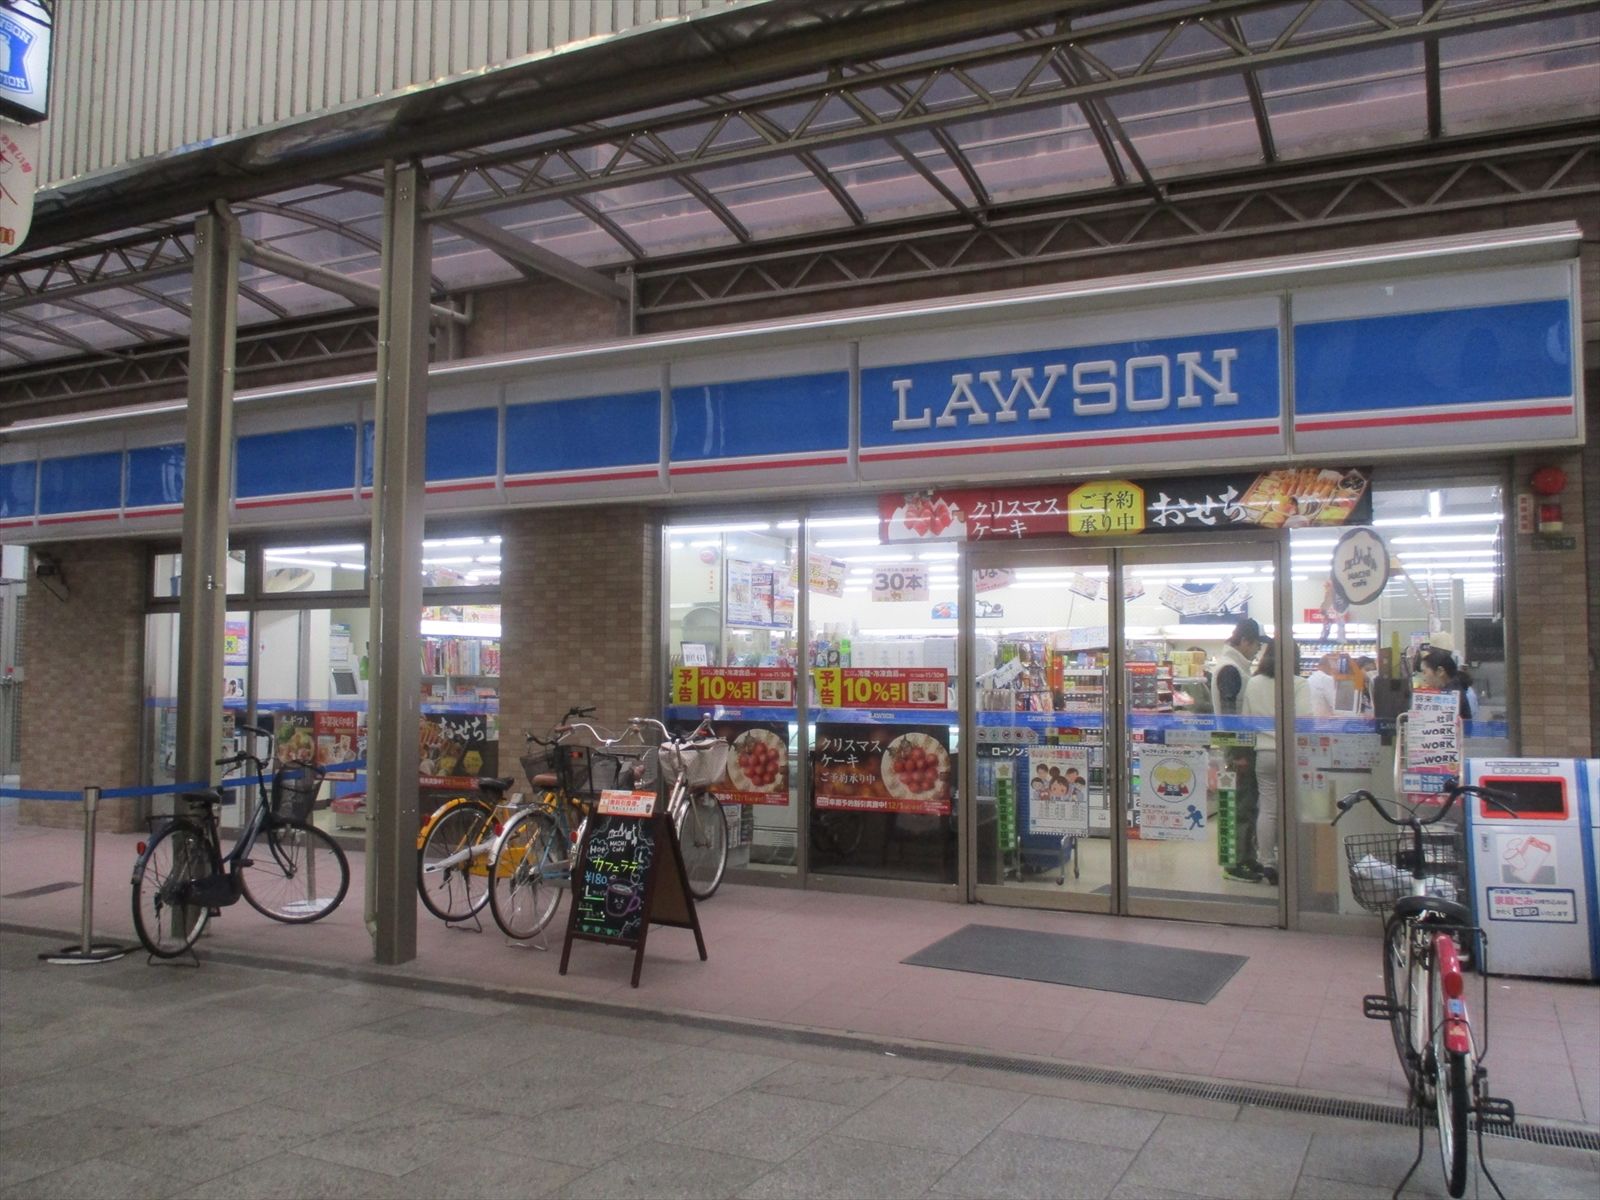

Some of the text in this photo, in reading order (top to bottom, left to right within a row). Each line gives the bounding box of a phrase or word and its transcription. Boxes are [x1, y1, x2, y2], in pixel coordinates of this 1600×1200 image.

[891, 347, 1240, 432] LAWSON
[966, 497, 1061, 521] クリスマス
[1079, 490, 1134, 511] ご予約
[1151, 484, 1248, 527] おせち
[970, 519, 1028, 541] ケーキ
[1079, 511, 1135, 533] 承り中
[874, 572, 923, 592] 30本
[700, 676, 757, 700] 10%引
[819, 670, 835, 705] 予告
[843, 677, 907, 703] 10%引
[438, 715, 486, 742] おせち
[1422, 727, 1455, 736] WORK
[820, 737, 882, 752] クリスマス
[1421, 740, 1455, 750] WORK
[819, 755, 860, 769] ケーキ
[1423, 753, 1458, 764] WORK
[592, 858, 638, 873] カフェラテ
